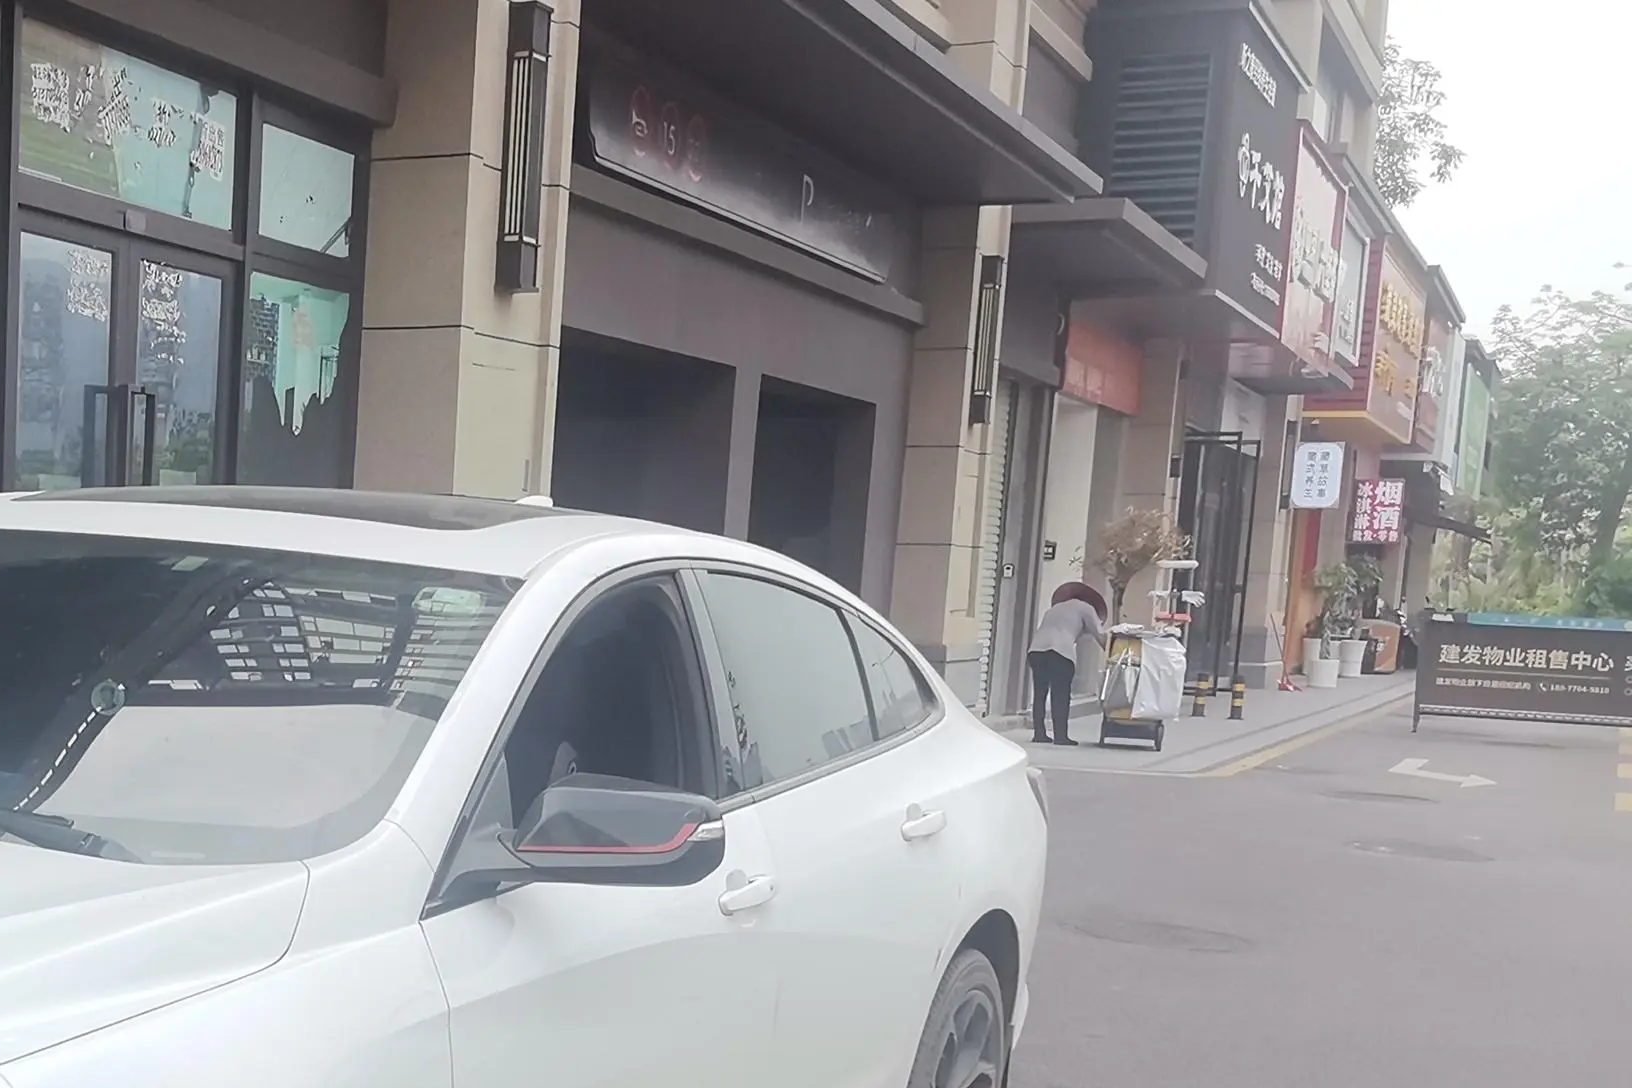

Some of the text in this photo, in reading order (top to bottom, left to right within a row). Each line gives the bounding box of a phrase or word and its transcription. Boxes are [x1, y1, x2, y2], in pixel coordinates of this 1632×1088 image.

[1354, 481, 1373, 530] 冰淇淋
[1373, 480, 1403, 530] 烟酒
[1438, 643, 1614, 673] 建发物业租售中心
